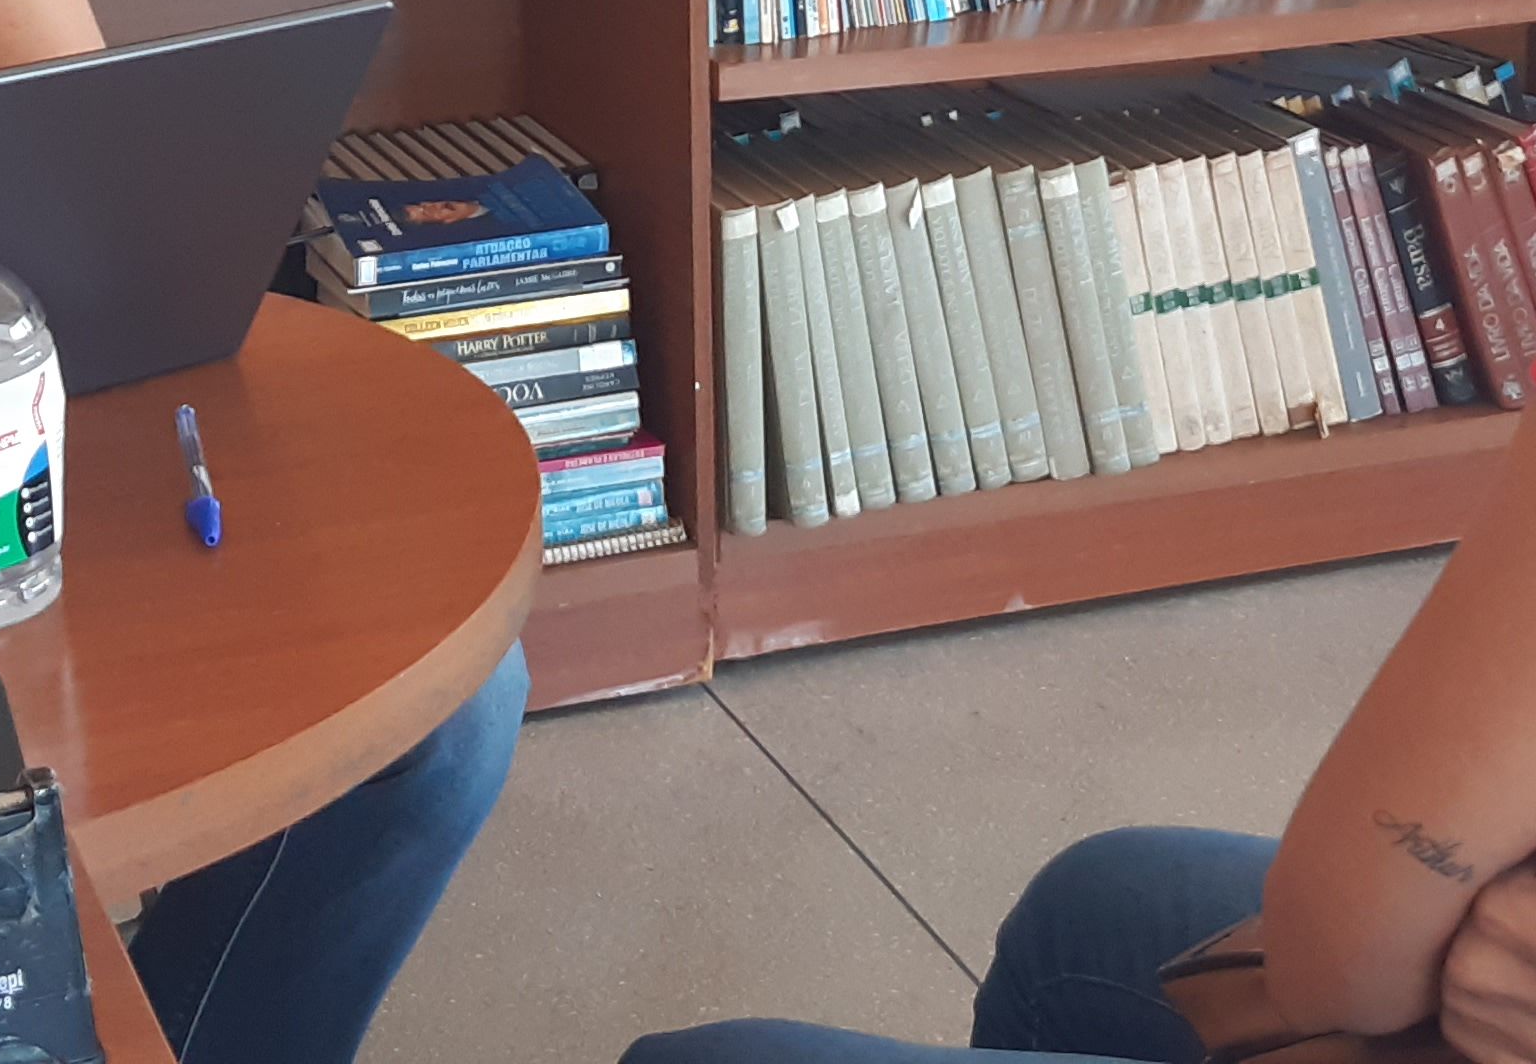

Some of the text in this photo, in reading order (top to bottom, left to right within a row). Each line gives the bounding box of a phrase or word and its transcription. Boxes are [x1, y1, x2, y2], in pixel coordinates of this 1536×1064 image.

[1403, 224, 1433, 291] Barsa
[457, 337, 499, 356] HARRY
[502, 331, 550, 350] POTTER
[494, 381, 544, 404] VOC
